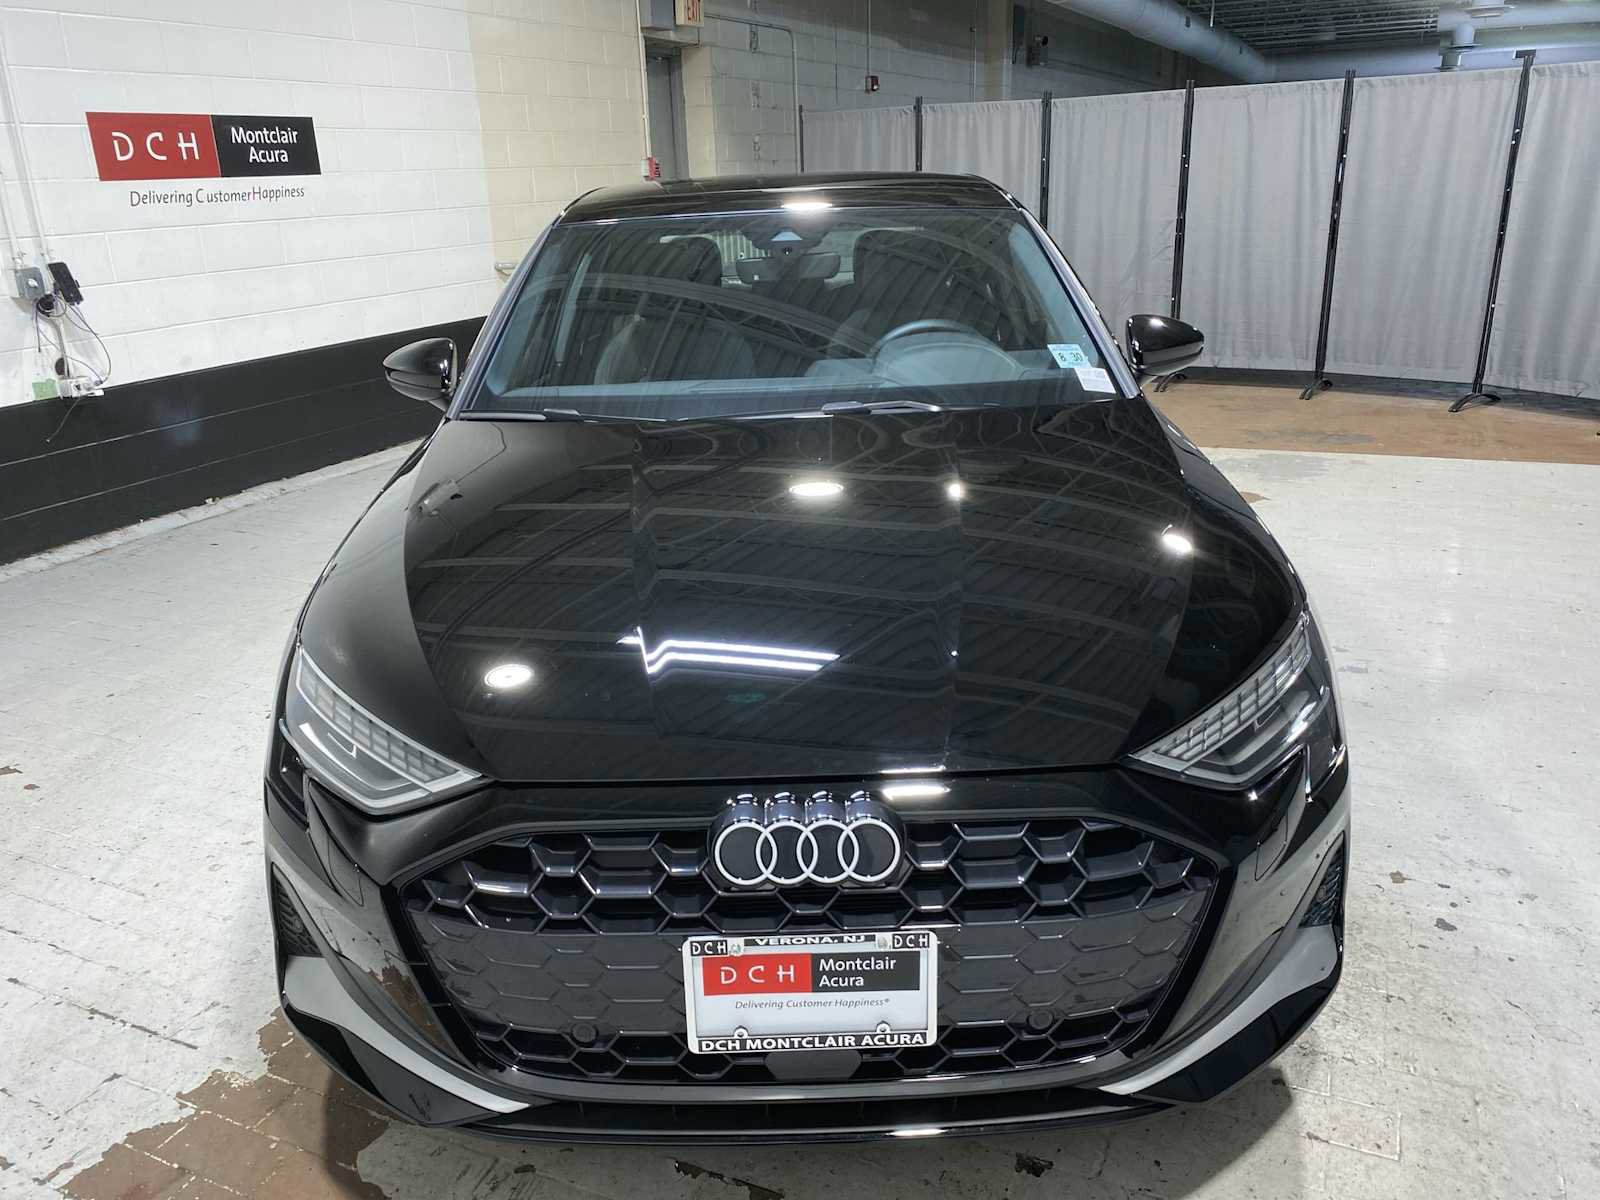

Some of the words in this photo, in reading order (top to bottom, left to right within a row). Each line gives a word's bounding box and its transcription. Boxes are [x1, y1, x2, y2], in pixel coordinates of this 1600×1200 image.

[230, 126, 298, 144] Montclair
[248, 147, 289, 163] Acura
[130, 190, 193, 207] Delivering
[843, 935, 865, 943] NJ
[894, 934, 929, 948] DCH
[692, 941, 727, 955] DCH
[819, 957, 896, 971] Montclair
[819, 974, 864, 987] Acura
[735, 1000, 784, 1010] Delivering
[786, 998, 832, 1009] Customer
[701, 1039, 741, 1052] DCH
[746, 1036, 856, 1050] MONTCLAIR
[861, 1033, 924, 1046] ACURA
